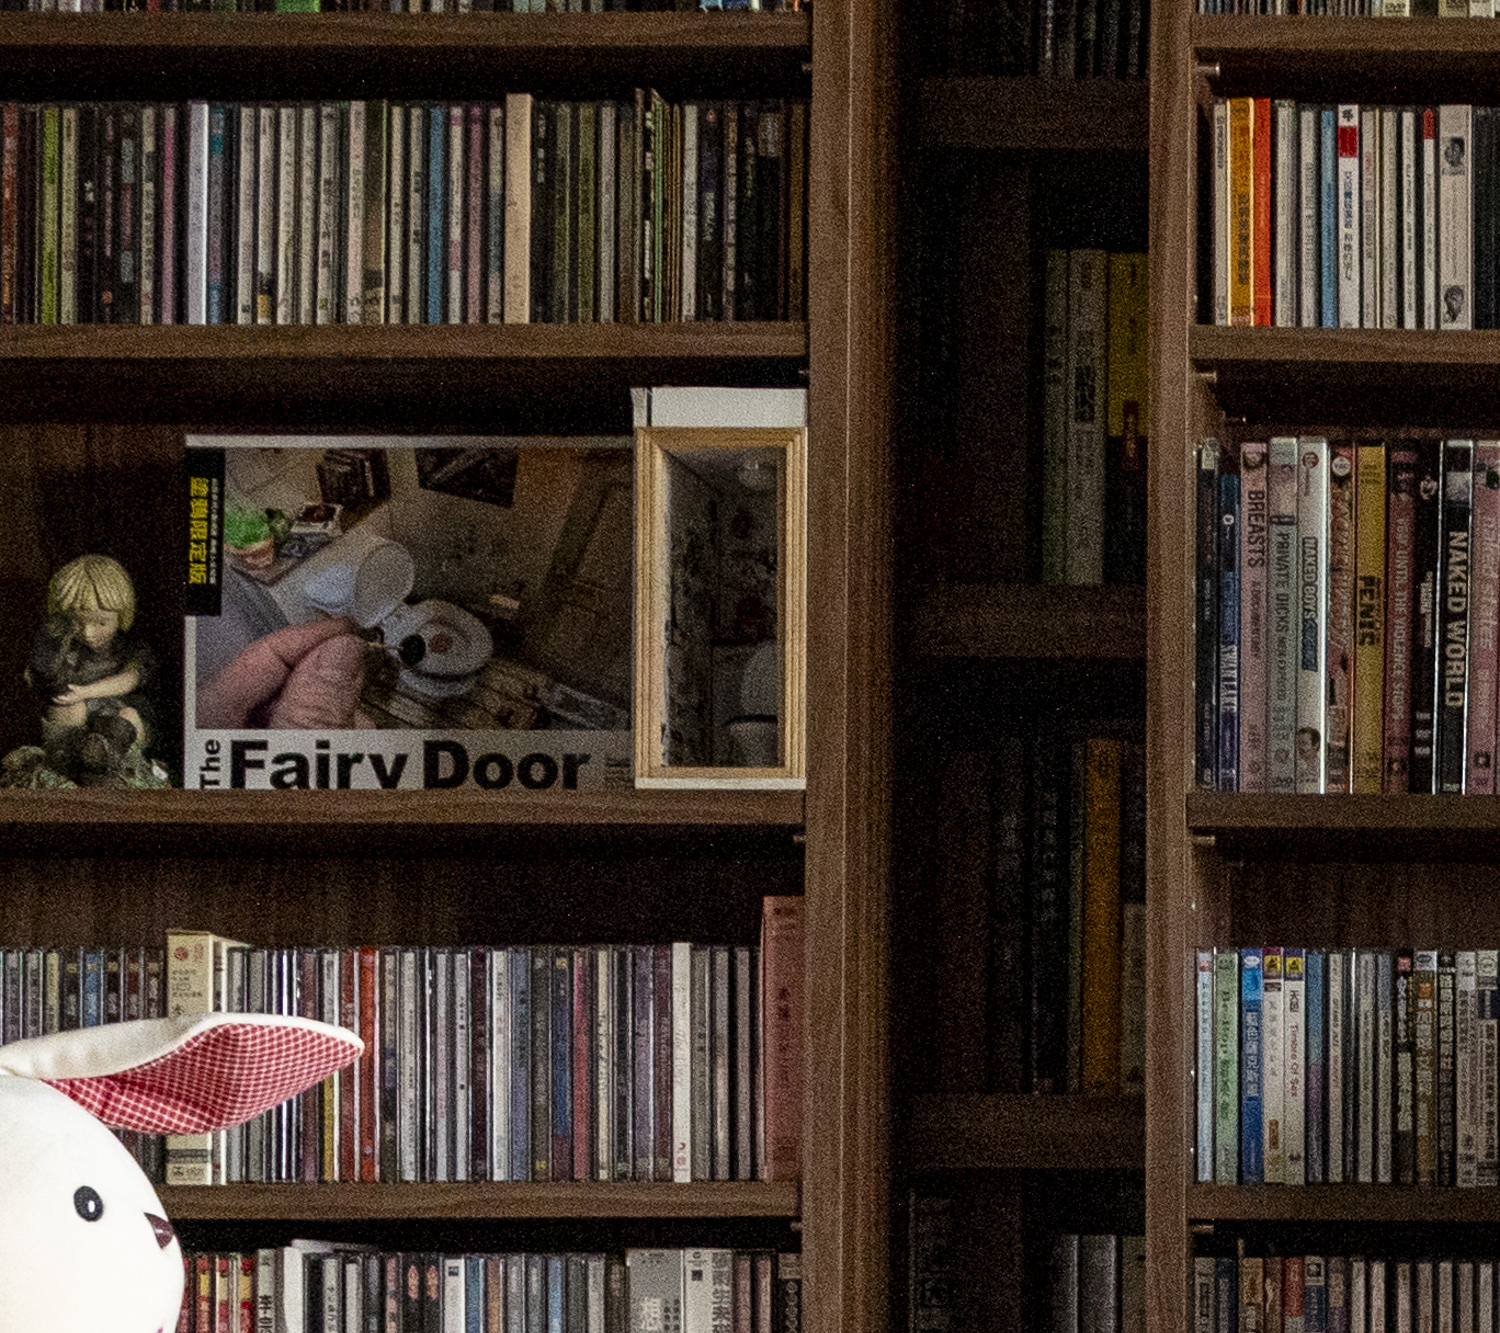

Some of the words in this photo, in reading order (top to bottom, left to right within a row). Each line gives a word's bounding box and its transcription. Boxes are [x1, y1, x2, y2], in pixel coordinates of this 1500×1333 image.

[1247, 489, 1265, 568] BREASTS
[1273, 532, 1290, 589] PRIVATE
[1448, 531, 1468, 614] NAKED
[1273, 593, 1289, 633] DICKS
[1445, 617, 1466, 708] WORLD
[199, 739, 221, 789] The
[423, 739, 590, 790] Door
